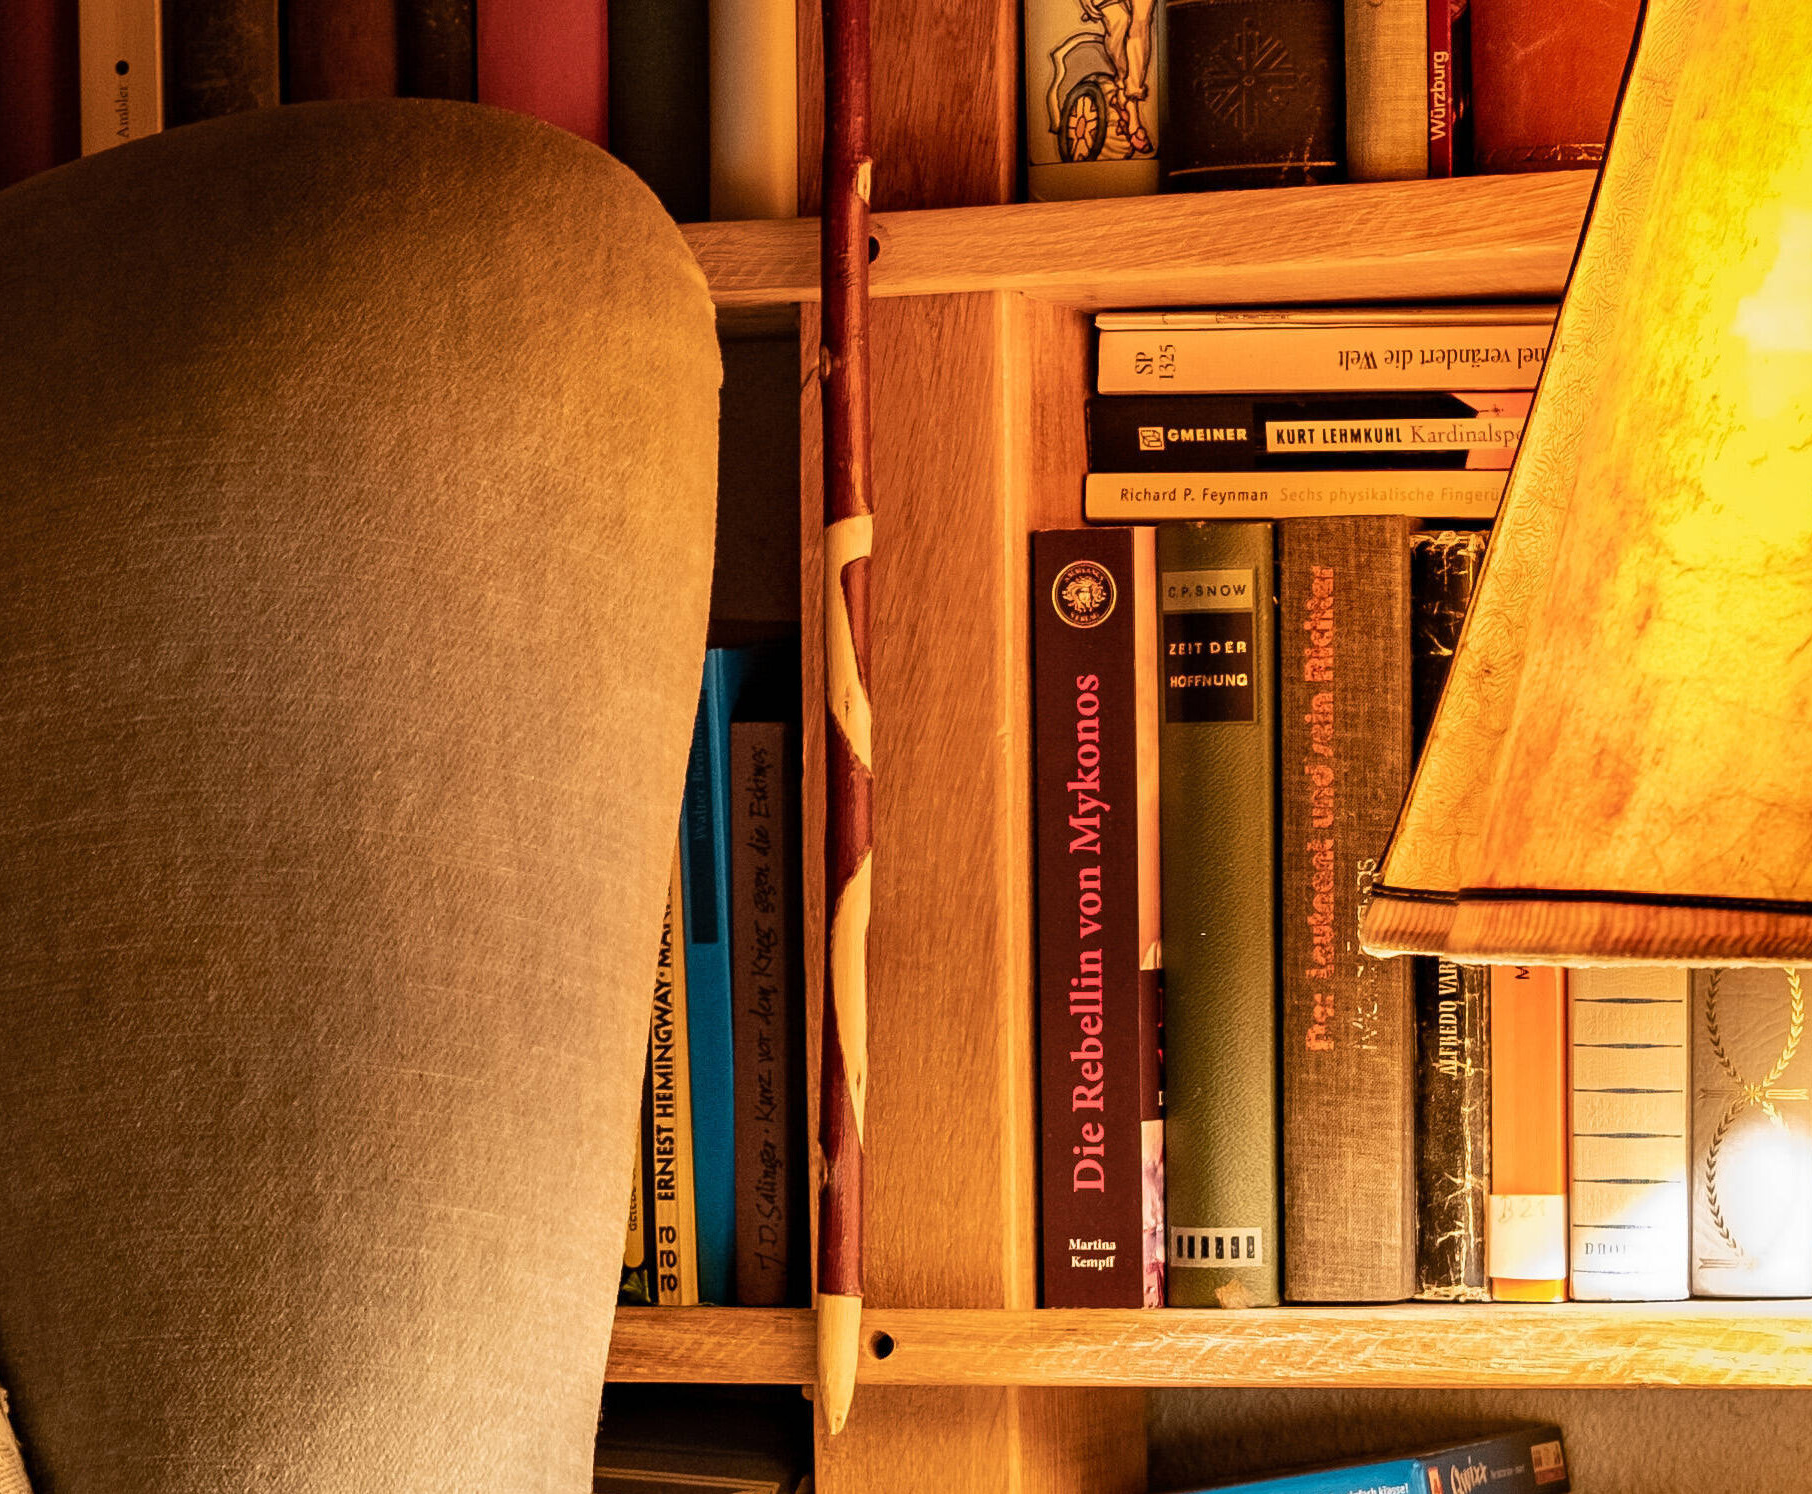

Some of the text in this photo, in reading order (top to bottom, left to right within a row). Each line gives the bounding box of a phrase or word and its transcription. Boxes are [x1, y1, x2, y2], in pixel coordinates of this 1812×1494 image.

[114, 86, 130, 139] Ambler
[1430, 51, 1450, 141] Würzburg
[1134, 352, 1154, 376] SP
[1158, 344, 1176, 381] 1325
[1338, 350, 1378, 372] Welt
[1383, 350, 1413, 371] die
[1419, 348, 1511, 370] verändert
[1166, 427, 1248, 442] GMEINER
[1276, 427, 1315, 444] KURT
[1322, 426, 1402, 444] LEHMKUHL
[1120, 487, 1176, 502] Richard
[1183, 488, 1194, 502] P.
[1202, 488, 1268, 505] Feynman
[1280, 487, 1323, 502] Sechs
[1329, 487, 1433, 505] physikalische
[1169, 640, 1247, 655] ZEIT DER
[1169, 673, 1248, 688] HOFFNUNG
[1304, 765, 1334, 828] und
[746, 825, 771, 856] die
[752, 864, 777, 913] gegen
[750, 920, 778, 977] Krieg
[1066, 674, 1111, 1192] Die Rebellin von Mykonos
[748, 986, 778, 1025] dem
[654, 978, 675, 1119] HEMINGWAY
[757, 1028, 774, 1062] vor
[1438, 1000, 1458, 1077] ALFREDO
[754, 1071, 777, 1123] Kurz
[656, 1124, 676, 1201] ERNEST
[754, 1140, 783, 1219] Salinger
[1068, 1238, 1117, 1251] Martina
[1071, 1255, 1116, 1272] Kempff
